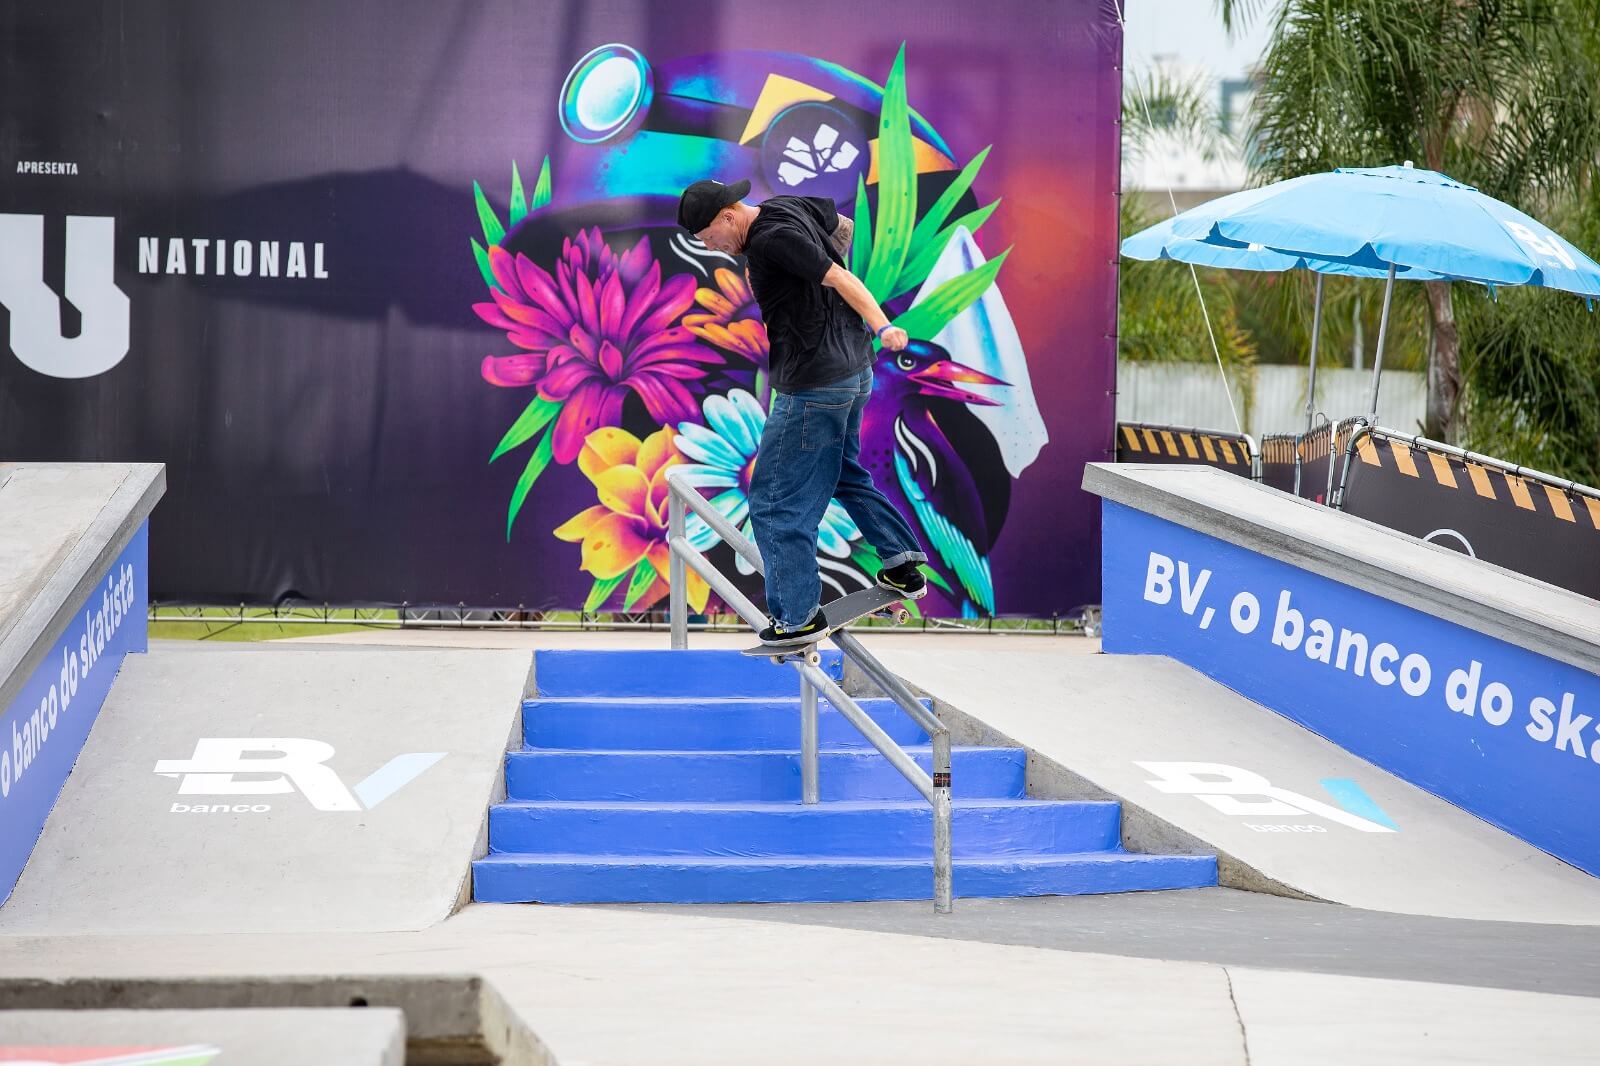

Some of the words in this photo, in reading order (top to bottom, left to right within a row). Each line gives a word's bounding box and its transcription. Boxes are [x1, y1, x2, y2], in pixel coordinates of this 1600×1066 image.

[16, 161, 78, 175] APRESENTA
[138, 236, 329, 279] NATIONAL
[1143, 551, 1216, 630] BV,
[1230, 591, 1261, 634] o
[1271, 589, 1432, 697] banco
[1445, 659, 1514, 726] do
[1, 750, 11, 797] o
[12, 684, 58, 783] banco
[60, 645, 78, 712] do
[80, 563, 134, 679] skatista
[168, 802, 271, 814] banco
[1242, 822, 1328, 834] banco
